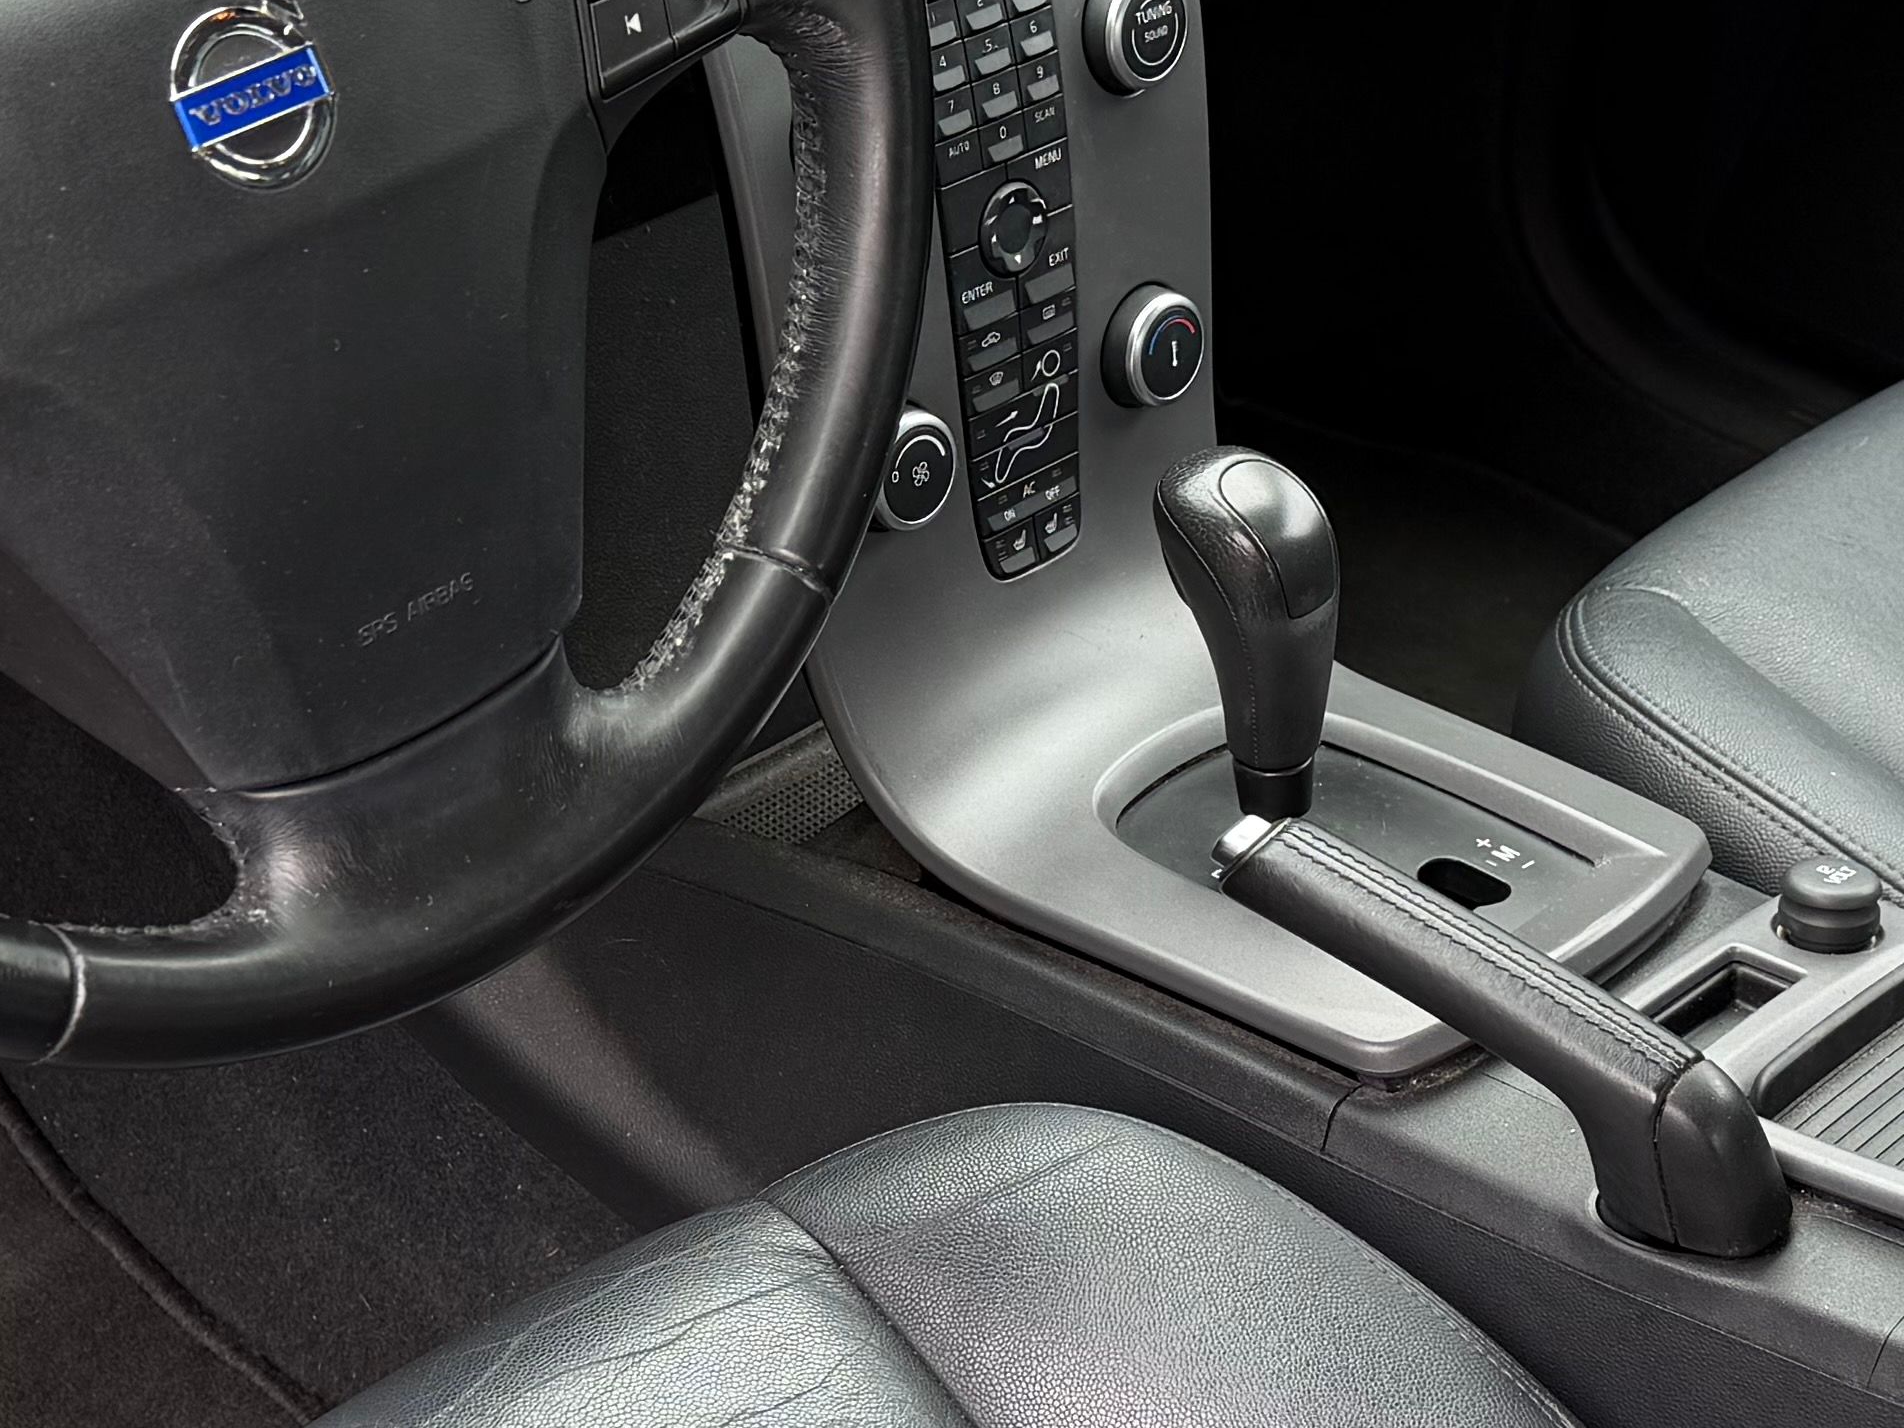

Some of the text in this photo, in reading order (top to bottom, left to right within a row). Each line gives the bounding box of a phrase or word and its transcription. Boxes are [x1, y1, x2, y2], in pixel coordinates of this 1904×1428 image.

[1135, 0, 1173, 25] TUNING
[1029, 19, 1038, 33] 6
[984, 38, 993, 52] 5
[939, 55, 947, 67] 4
[1036, 65, 1044, 79] 9
[188, 65, 317, 126] VOLVO
[992, 82, 1001, 95] 8
[947, 99, 955, 113] 7
[1034, 106, 1056, 123] SCAN
[999, 125, 1007, 139] 0
[948, 140, 970, 158] AUTO
[1034, 147, 1062, 169] MENU
[1048, 247, 1069, 266] EXIT
[961, 281, 994, 304] ENTER
[358, 611, 398, 647] SRS
